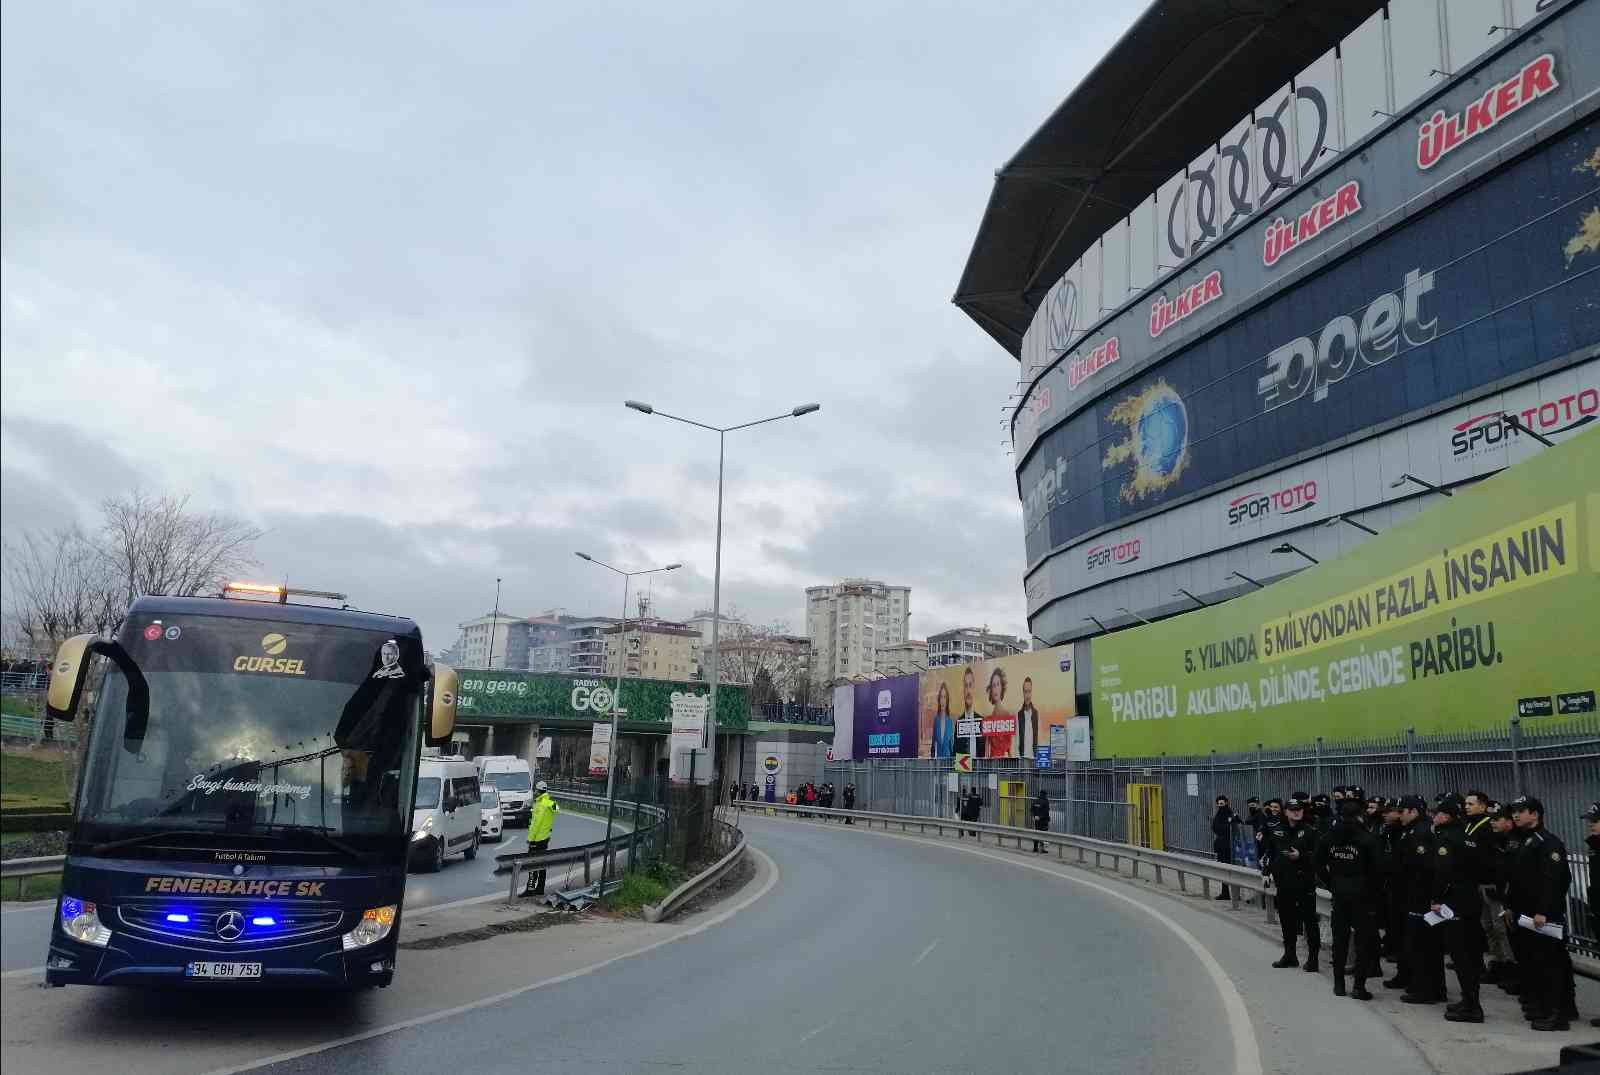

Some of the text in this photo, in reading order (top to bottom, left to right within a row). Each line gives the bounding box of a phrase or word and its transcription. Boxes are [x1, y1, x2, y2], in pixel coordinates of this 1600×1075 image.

[1417, 54, 1559, 169] ÜLKER
[1264, 180, 1362, 266] ÜLKER
[1150, 271, 1223, 338] ÜLKER
[1068, 337, 1120, 390] ÜLKER
[1185, 518, 1566, 673] 5. YILINDA 5 MİLYONDAN FAZLA İNSANIN
[1187, 617, 1503, 715] AKLINDA, DİLİNDE, CEBİNDE PARİBU.
[463, 679, 528, 697] en genç
[571, 687, 627, 713] GOL
[187, 774, 223, 795] Sevgi
[215, 852, 237, 861] Futbol
[145, 877, 326, 899] FENERBAHÇE SK
[194, 963, 260, 976] 34 CBH 753
